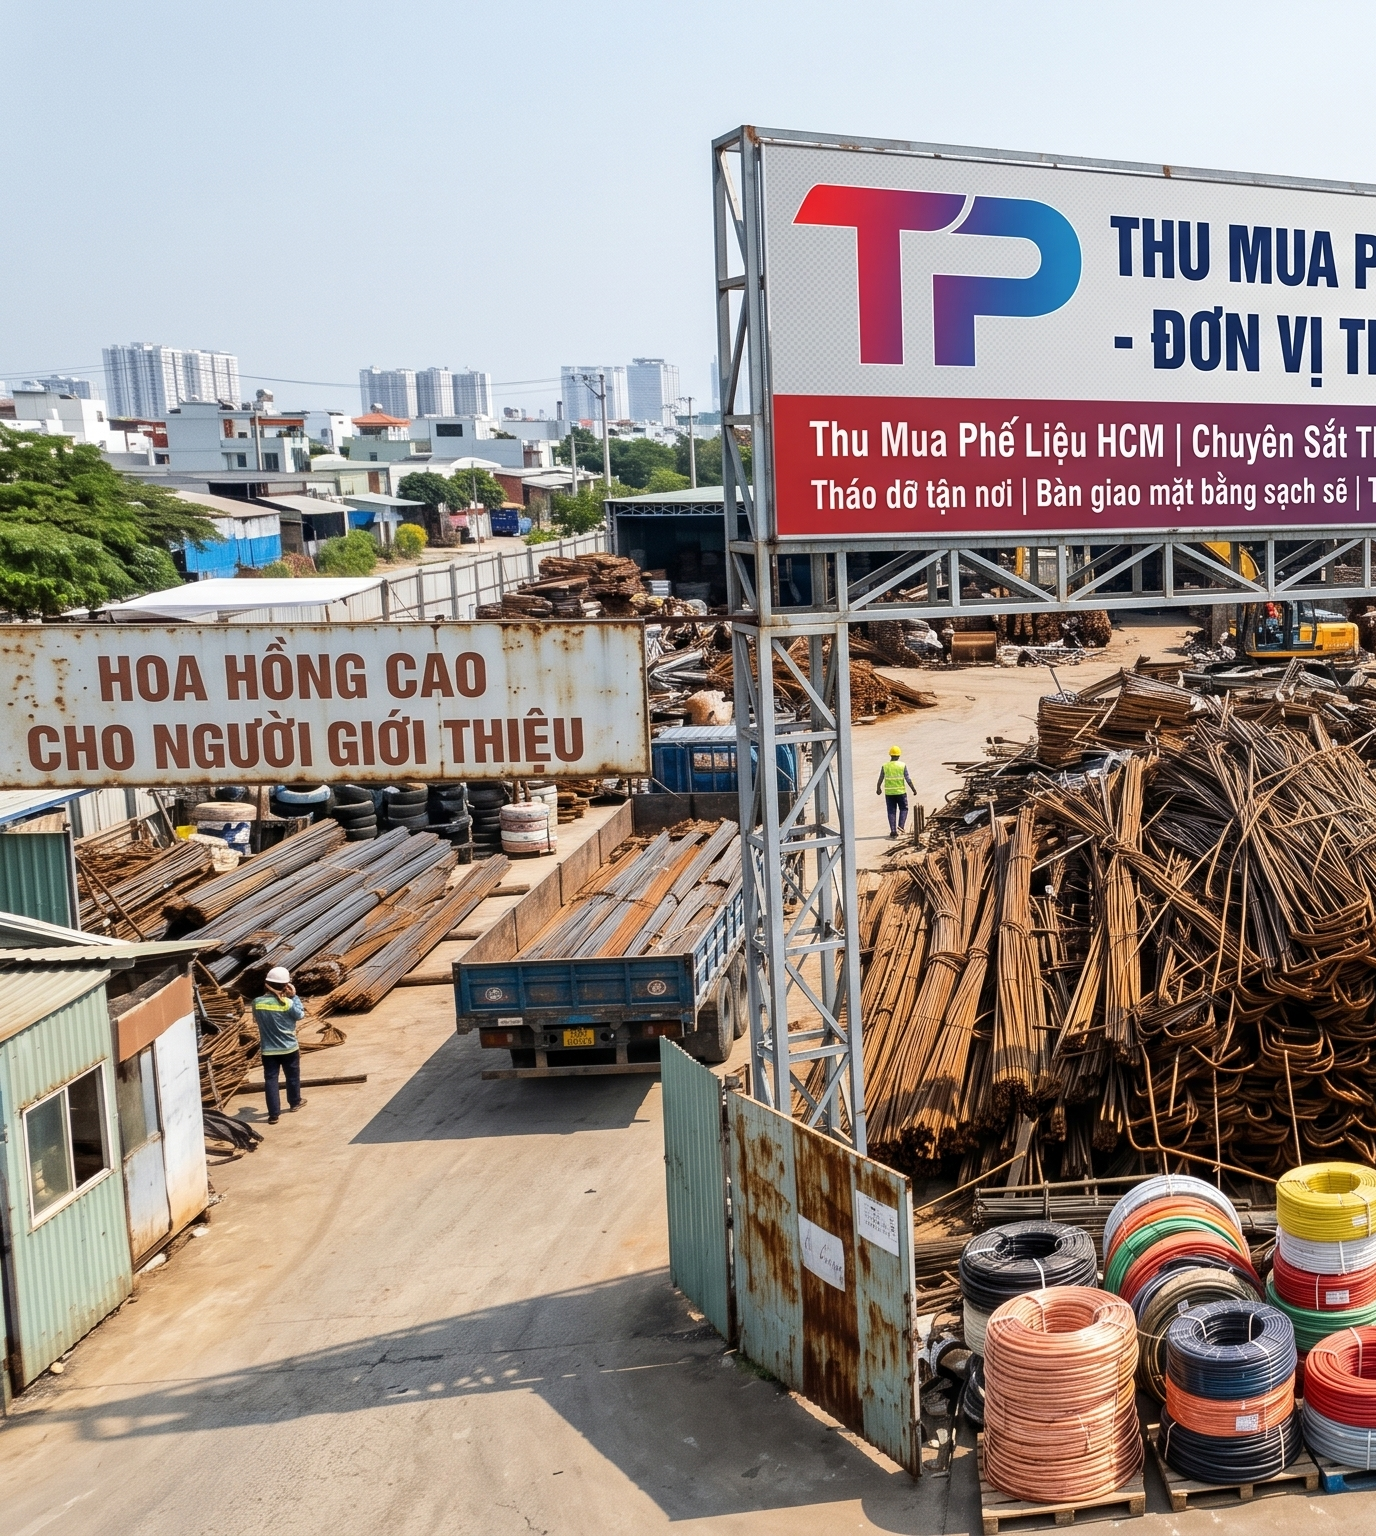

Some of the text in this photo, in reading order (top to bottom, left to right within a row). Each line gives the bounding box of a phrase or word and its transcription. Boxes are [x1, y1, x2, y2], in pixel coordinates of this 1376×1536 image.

[792, 182, 1083, 367] TP
[1110, 215, 1210, 281] THU
[1228, 224, 1339, 289] MUA
[1150, 305, 1260, 372] ĐƠN
[1276, 314, 1323, 388] VỊ
[809, 420, 869, 458] Thu
[881, 421, 947, 458] Mua
[959, 415, 1020, 458] Phế
[1025, 422, 1087, 466] Liệu
[1097, 423, 1164, 458] HCM
[1192, 423, 1294, 465] Chuyên
[1304, 417, 1348, 459] Sắt
[810, 477, 877, 510] Tháo
[886, 479, 918, 509] dỡ
[925, 478, 966, 515] tận
[975, 478, 1012, 508] nơi
[1036, 477, 1082, 507] Bàn
[1090, 478, 1141, 514] giao
[1149, 477, 1194, 512] mặt
[1201, 471, 1257, 511] bằng
[1264, 477, 1315, 511] sạch
[1323, 477, 1348, 504] sẽ
[97, 636, 487, 703] HOA HỒNG CAO
[27, 707, 584, 773] CHO NGƯỜI GIỚI THIỆU
